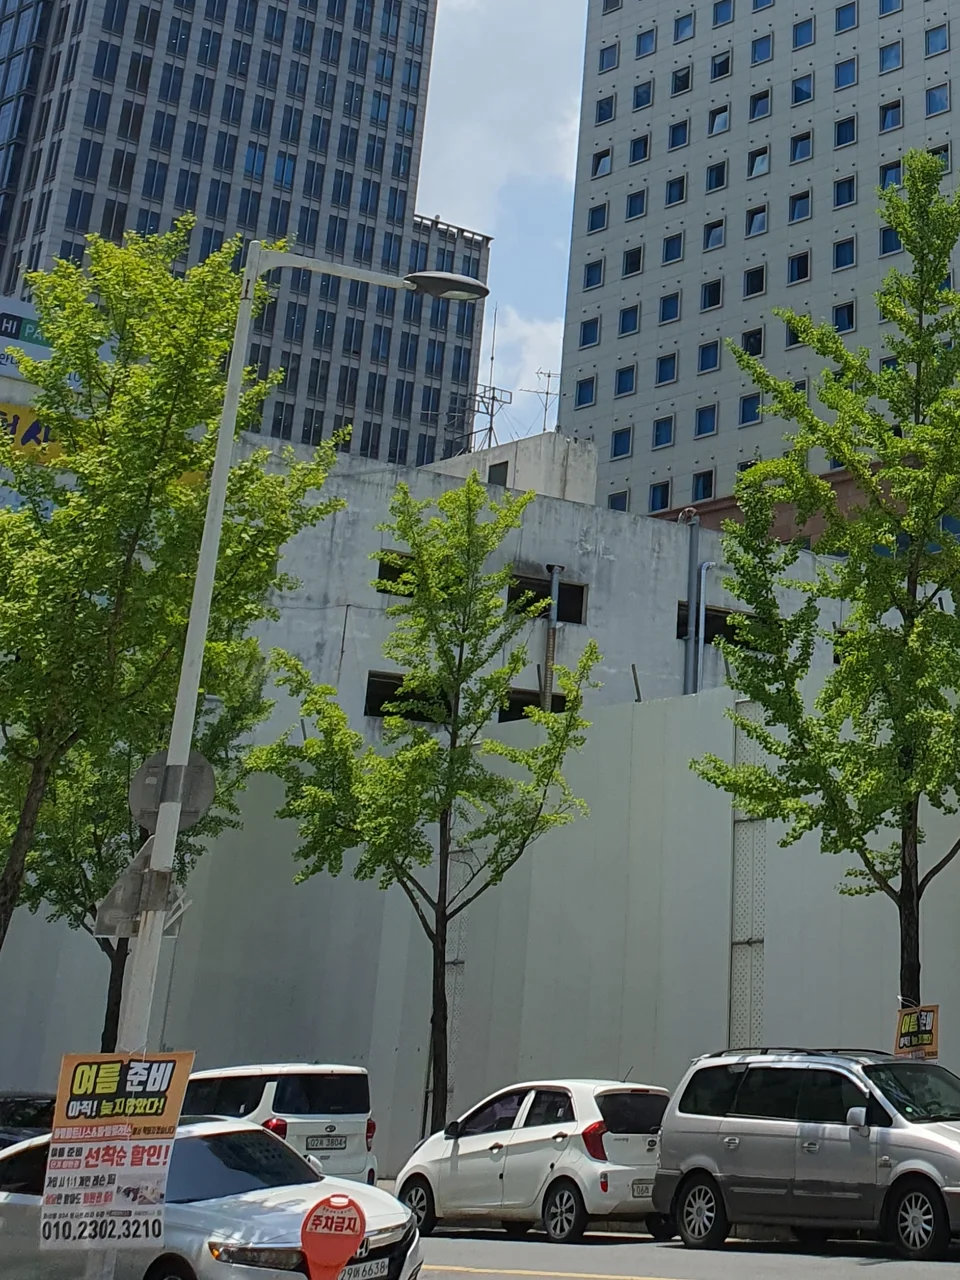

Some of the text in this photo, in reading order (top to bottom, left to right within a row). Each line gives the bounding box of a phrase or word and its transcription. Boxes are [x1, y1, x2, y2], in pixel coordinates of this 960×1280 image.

[72, 1061, 174, 1095] 여름 준비
[67, 1100, 98, 1117] 아직!
[84, 1145, 127, 1169] 선착순
[130, 1144, 170, 1167] 할인!
[311, 1214, 358, 1233] 주차금지
